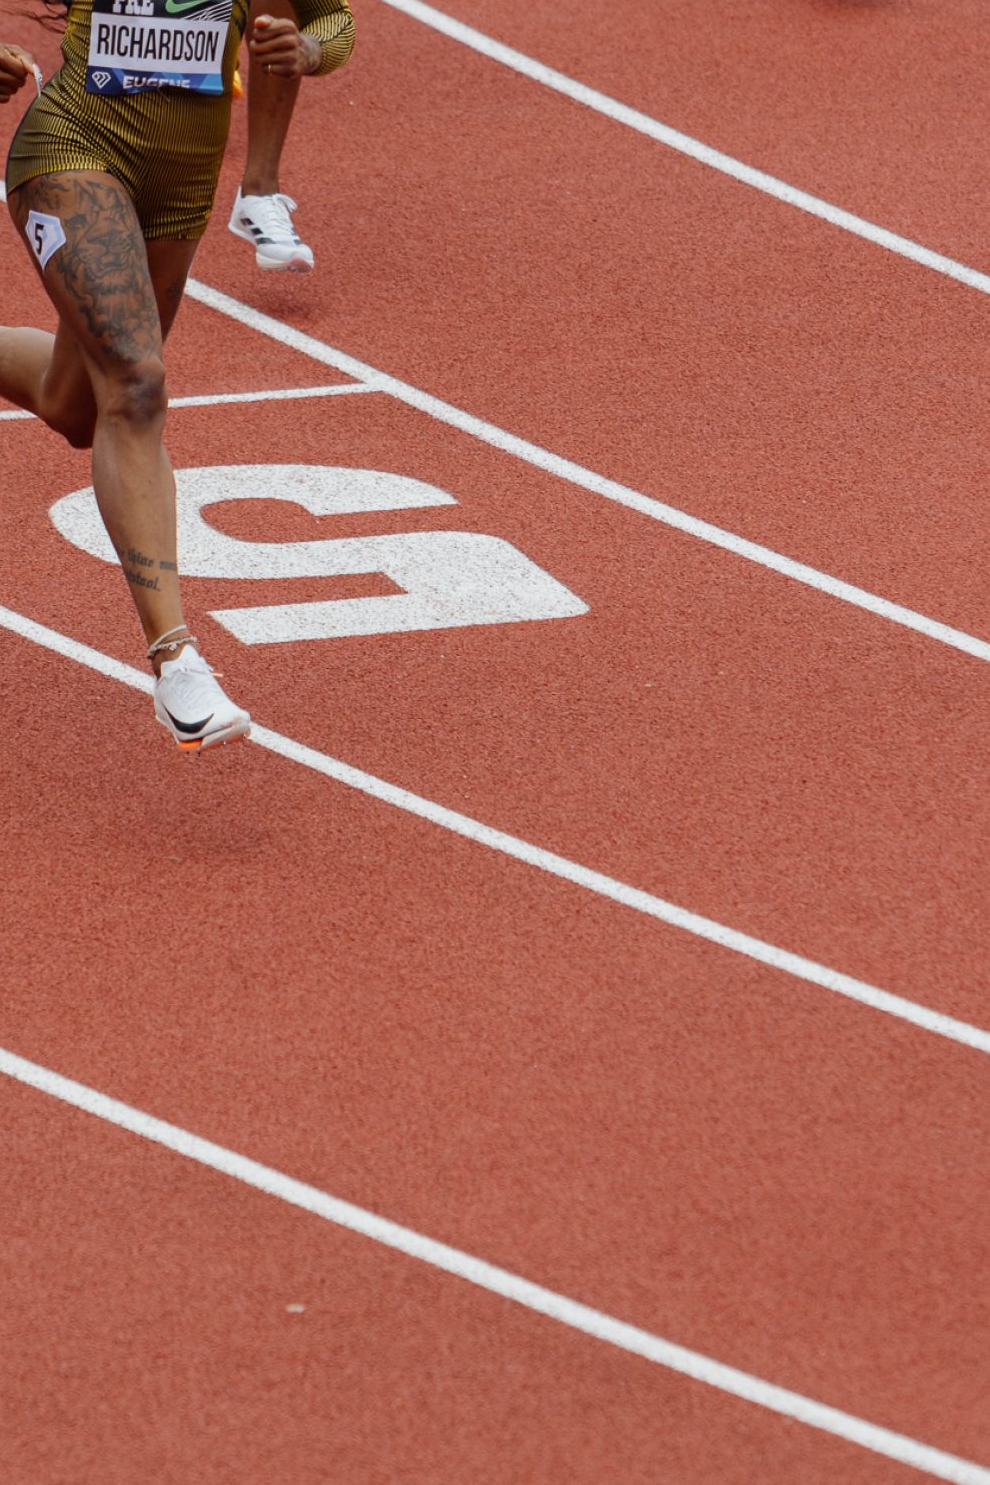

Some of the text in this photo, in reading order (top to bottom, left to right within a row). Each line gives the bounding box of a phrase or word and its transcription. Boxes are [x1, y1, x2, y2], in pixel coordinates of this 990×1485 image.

[96, 23, 220, 63] RICHARDSON
[34, 222, 45, 256] 5
[48, 463, 591, 645] 5
